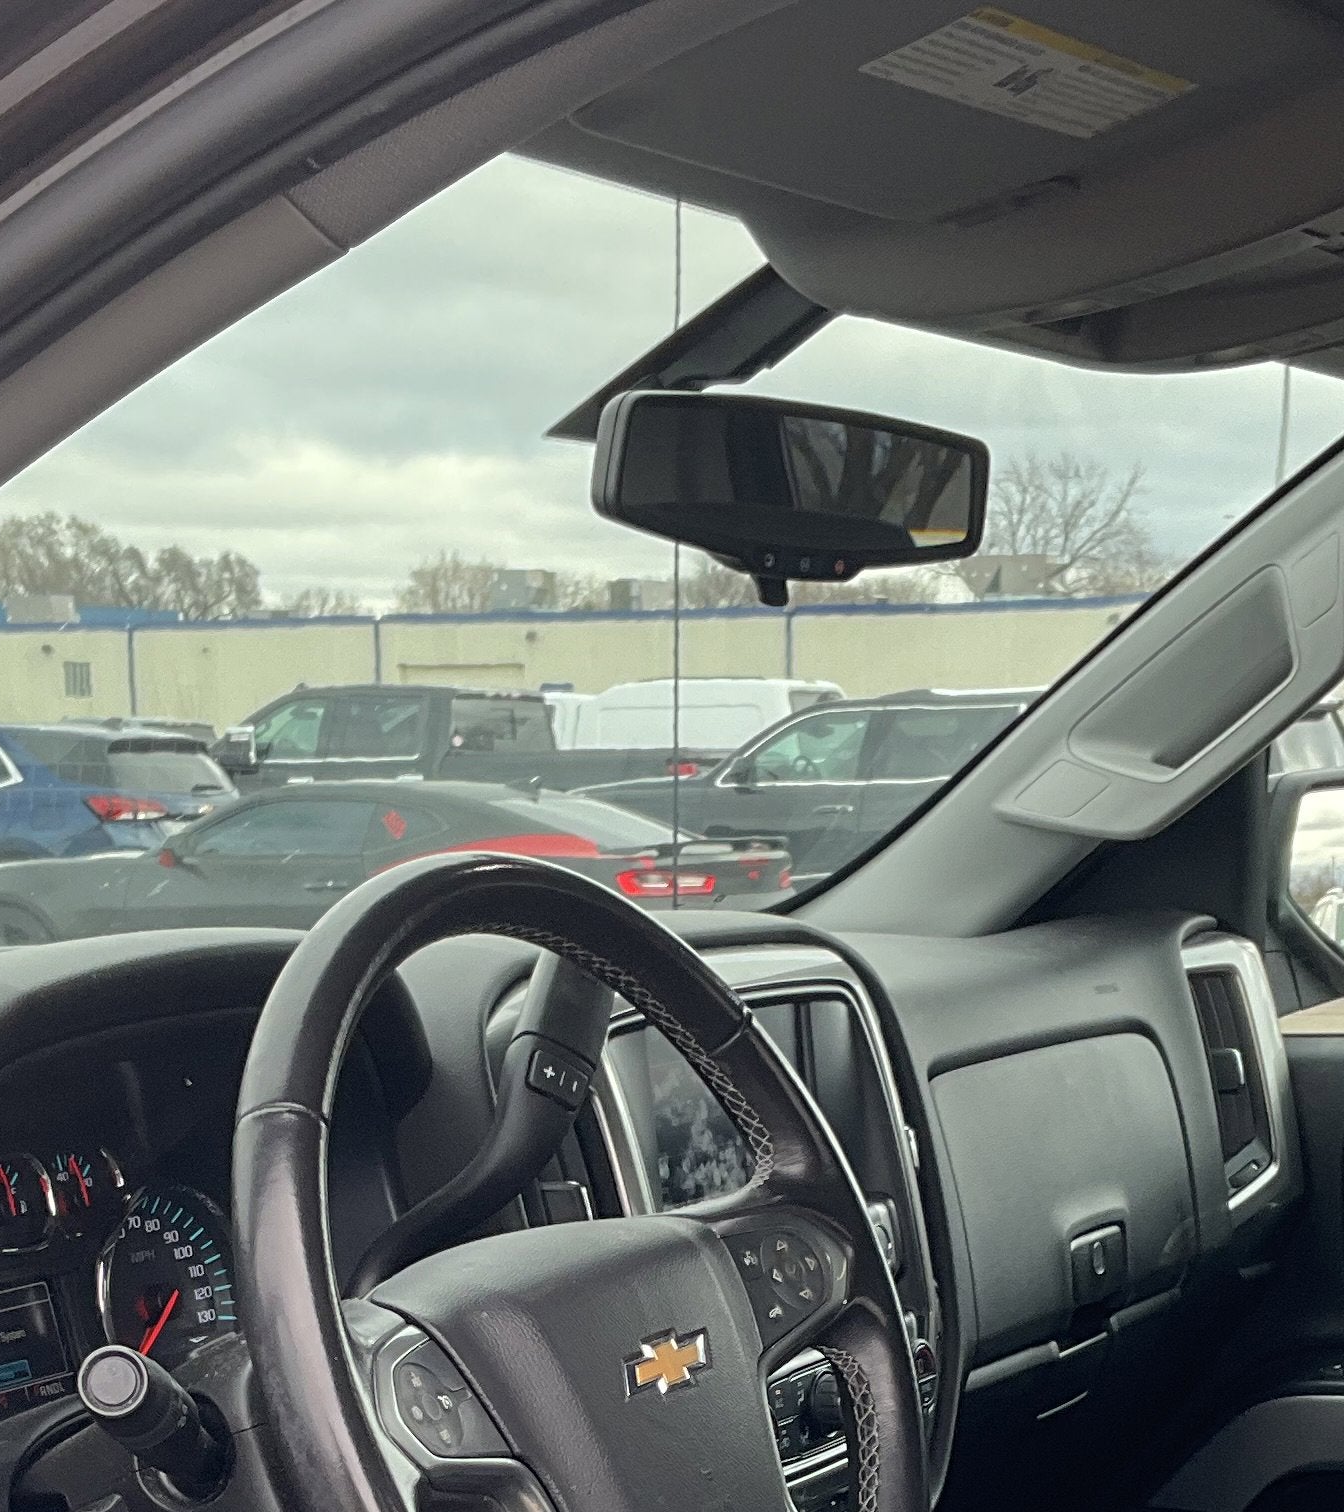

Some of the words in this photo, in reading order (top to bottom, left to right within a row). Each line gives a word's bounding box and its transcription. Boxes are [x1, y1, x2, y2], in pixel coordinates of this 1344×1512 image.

[127, 1215, 142, 1230] 70
[144, 1218, 161, 1233] 80
[163, 1230, 179, 1245] 90
[173, 1245, 193, 1260] 100
[188, 1264, 205, 1278] 110
[193, 1285, 213, 1300] 120
[197, 1308, 216, 1324] 130
